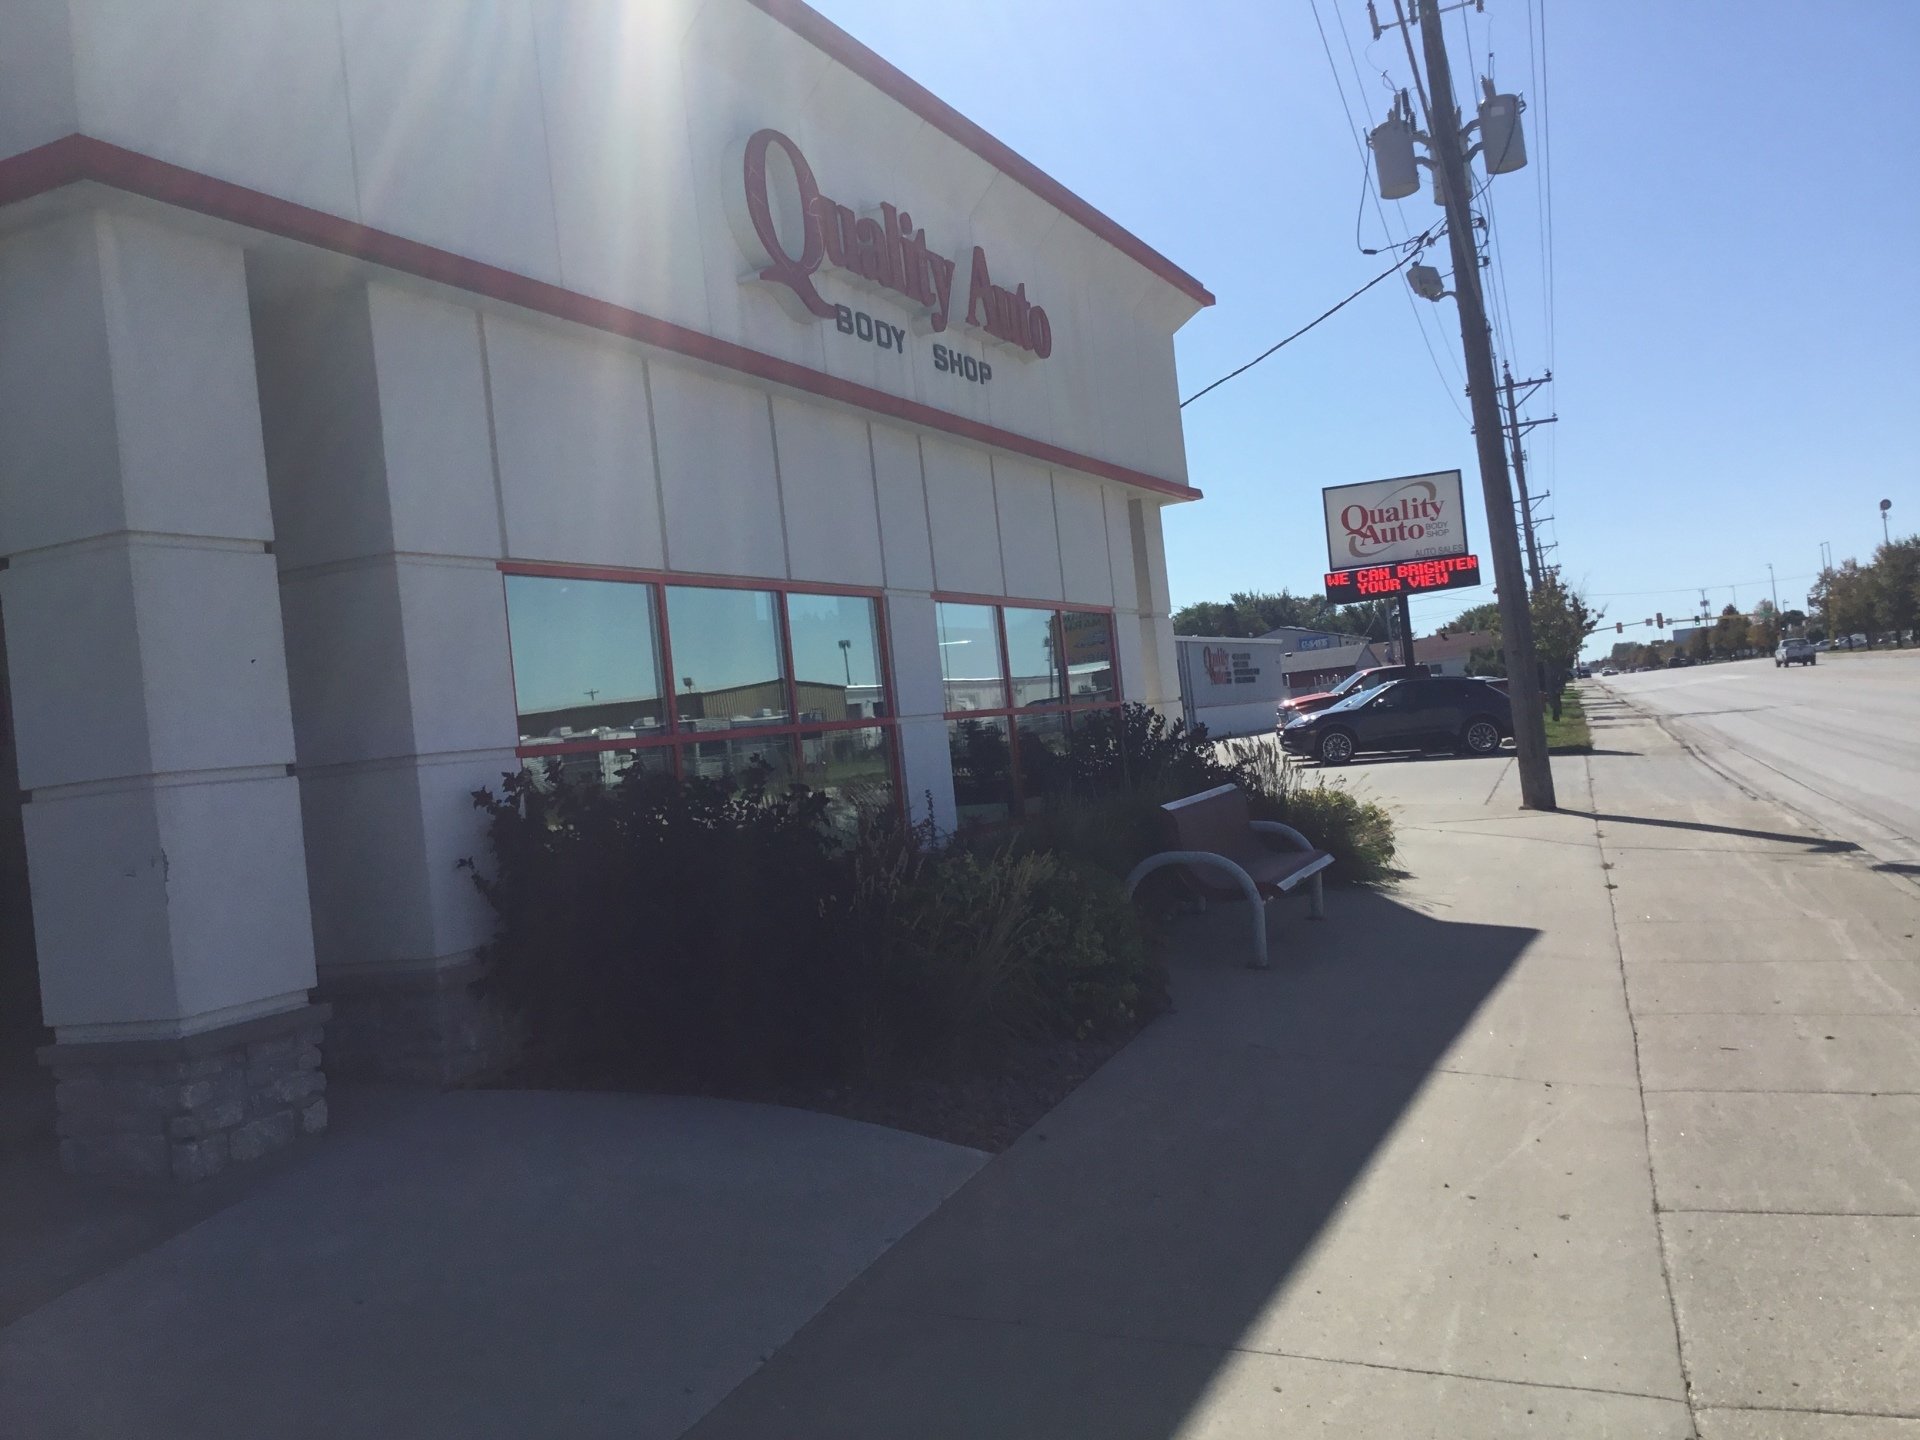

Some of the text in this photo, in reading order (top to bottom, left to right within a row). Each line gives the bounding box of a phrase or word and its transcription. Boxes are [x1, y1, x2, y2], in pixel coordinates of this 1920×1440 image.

[744, 128, 1052, 359] Quality Auto
[834, 303, 992, 385] BODY SHOP
[1340, 497, 1445, 539] Quality
[1425, 520, 1448, 531] BODY
[1360, 521, 1424, 546] Auto
[1426, 528, 1450, 538] SHOP
[1414, 543, 1463, 558] AUTO SALES
[1326, 556, 1478, 587] WE CAN BRIGHTEN
[1357, 573, 1449, 595] YOUR VIEW
